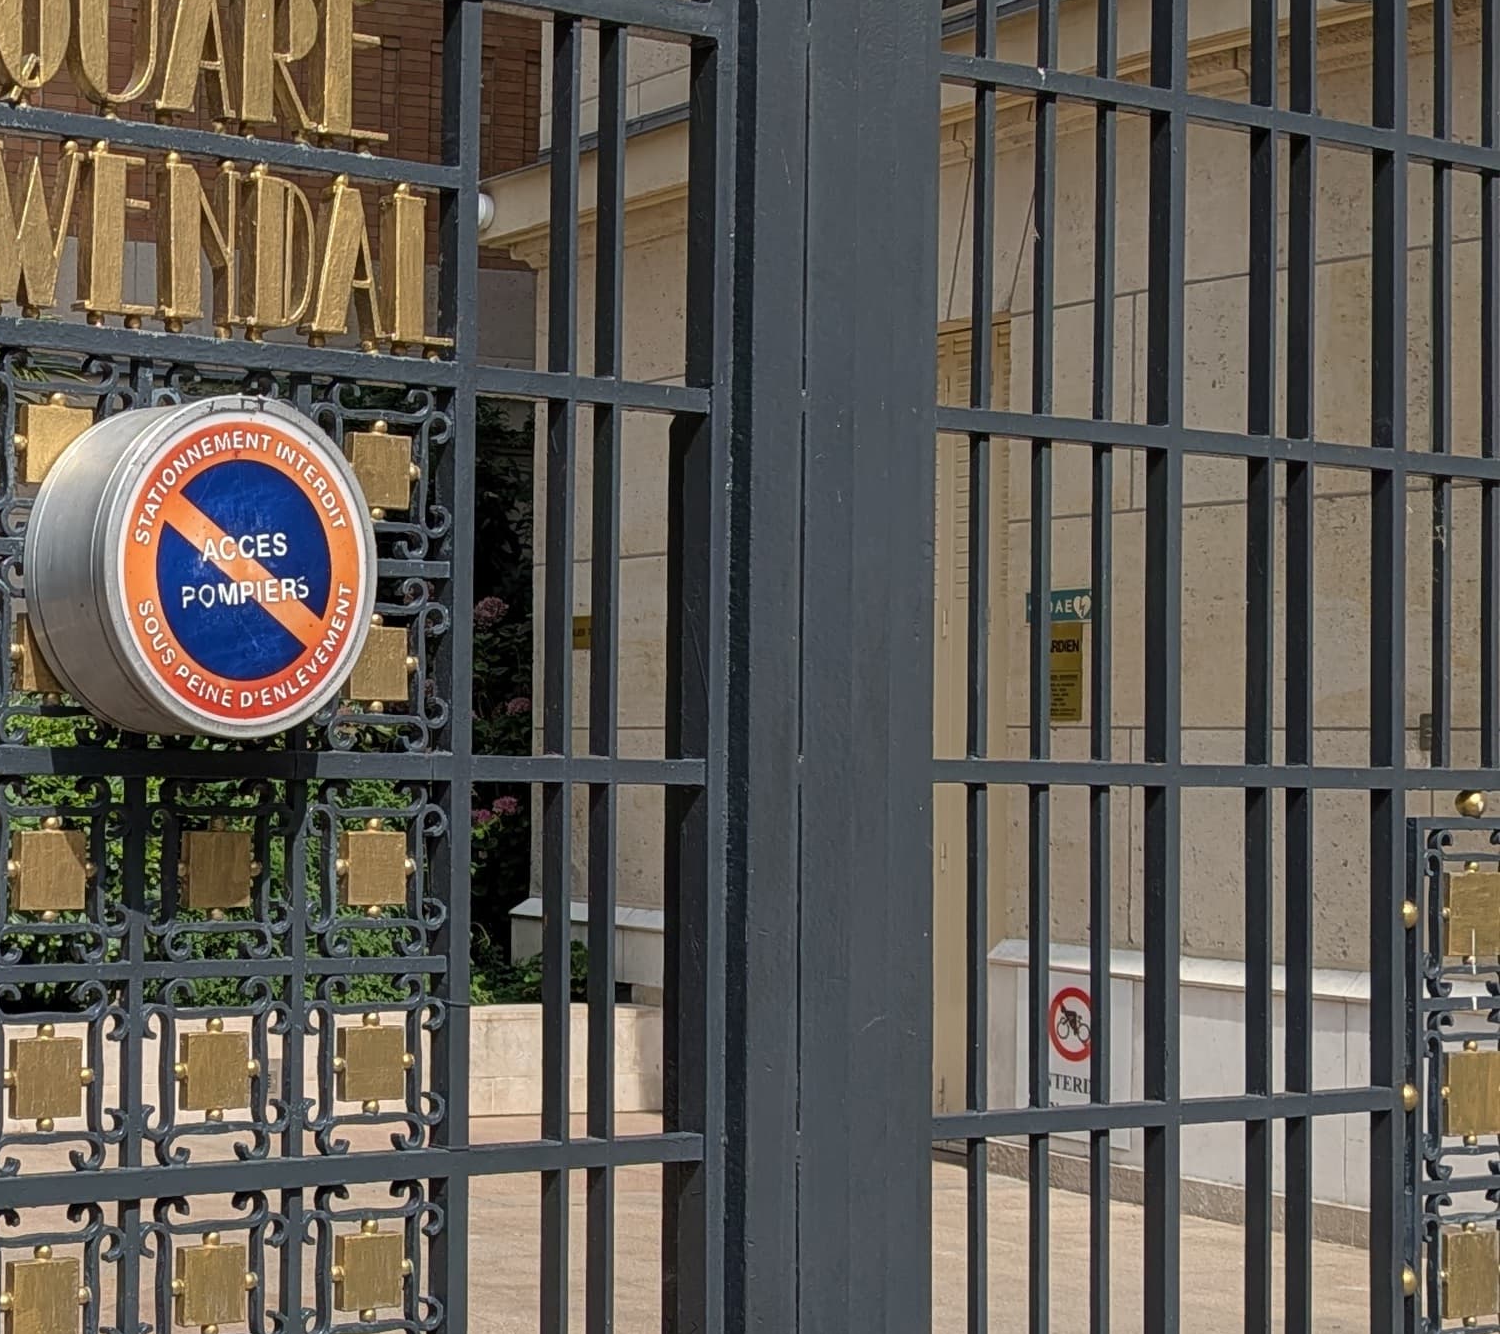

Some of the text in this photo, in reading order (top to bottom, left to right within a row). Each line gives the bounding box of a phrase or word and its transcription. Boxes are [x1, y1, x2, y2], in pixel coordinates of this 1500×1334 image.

[135, 430, 347, 545] STATIONNEMENT INTERDIT
[202, 532, 288, 562] ACCES
[181, 576, 310, 609] POMPIERS
[138, 582, 353, 708] SOUS PEINE D'ENLEVEMENT
